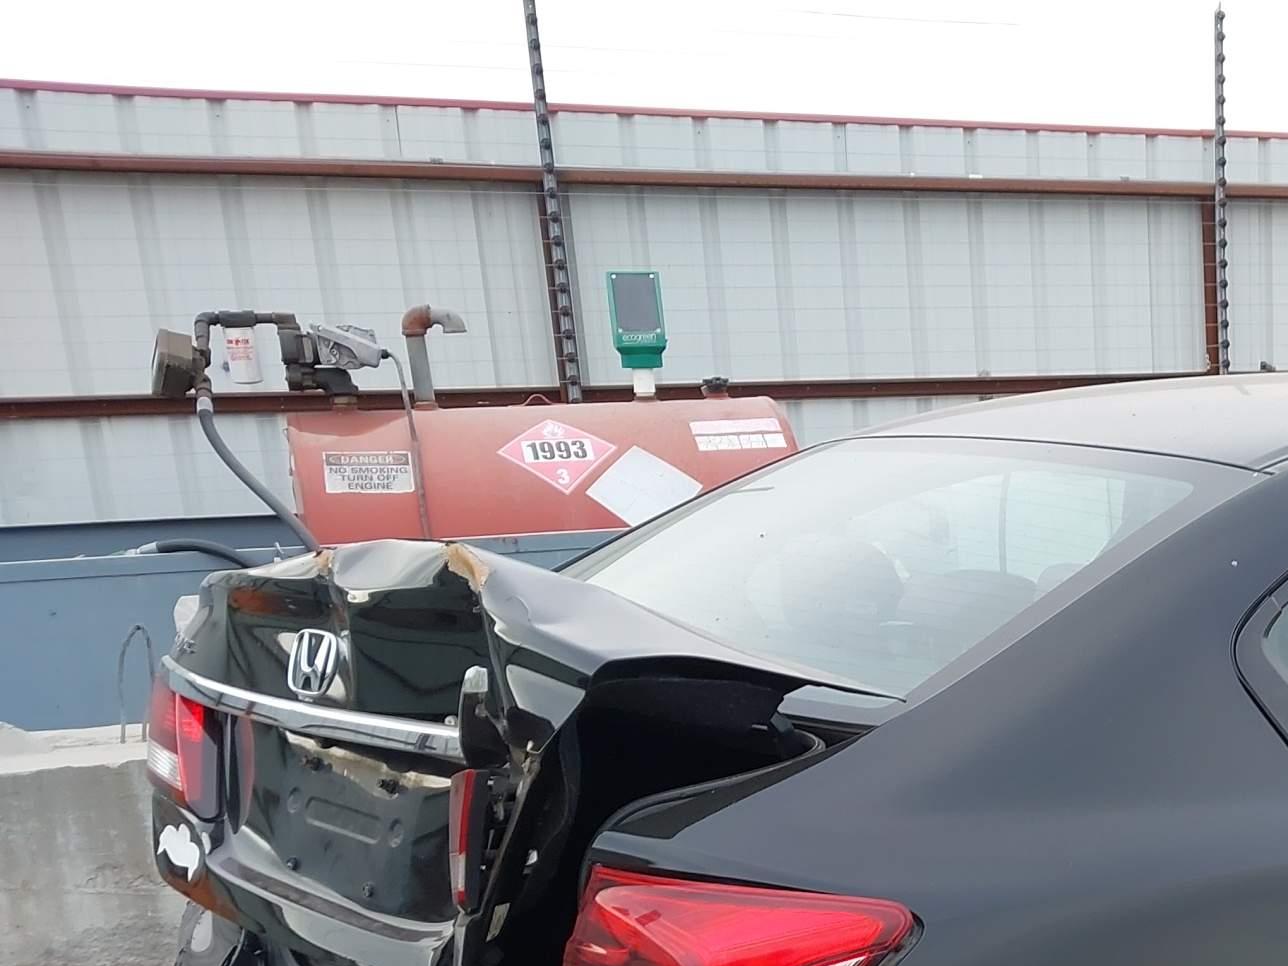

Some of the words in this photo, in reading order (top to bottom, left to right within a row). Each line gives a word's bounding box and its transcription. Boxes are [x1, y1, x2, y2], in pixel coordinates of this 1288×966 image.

[526, 439, 588, 461] 1993
[341, 455, 394, 464] DANGER
[351, 466, 408, 474] SMOKING
[341, 474, 373, 482] TURN
[377, 474, 398, 482] OFF
[556, 468, 570, 485] 3
[347, 482, 393, 490] ENGINE
